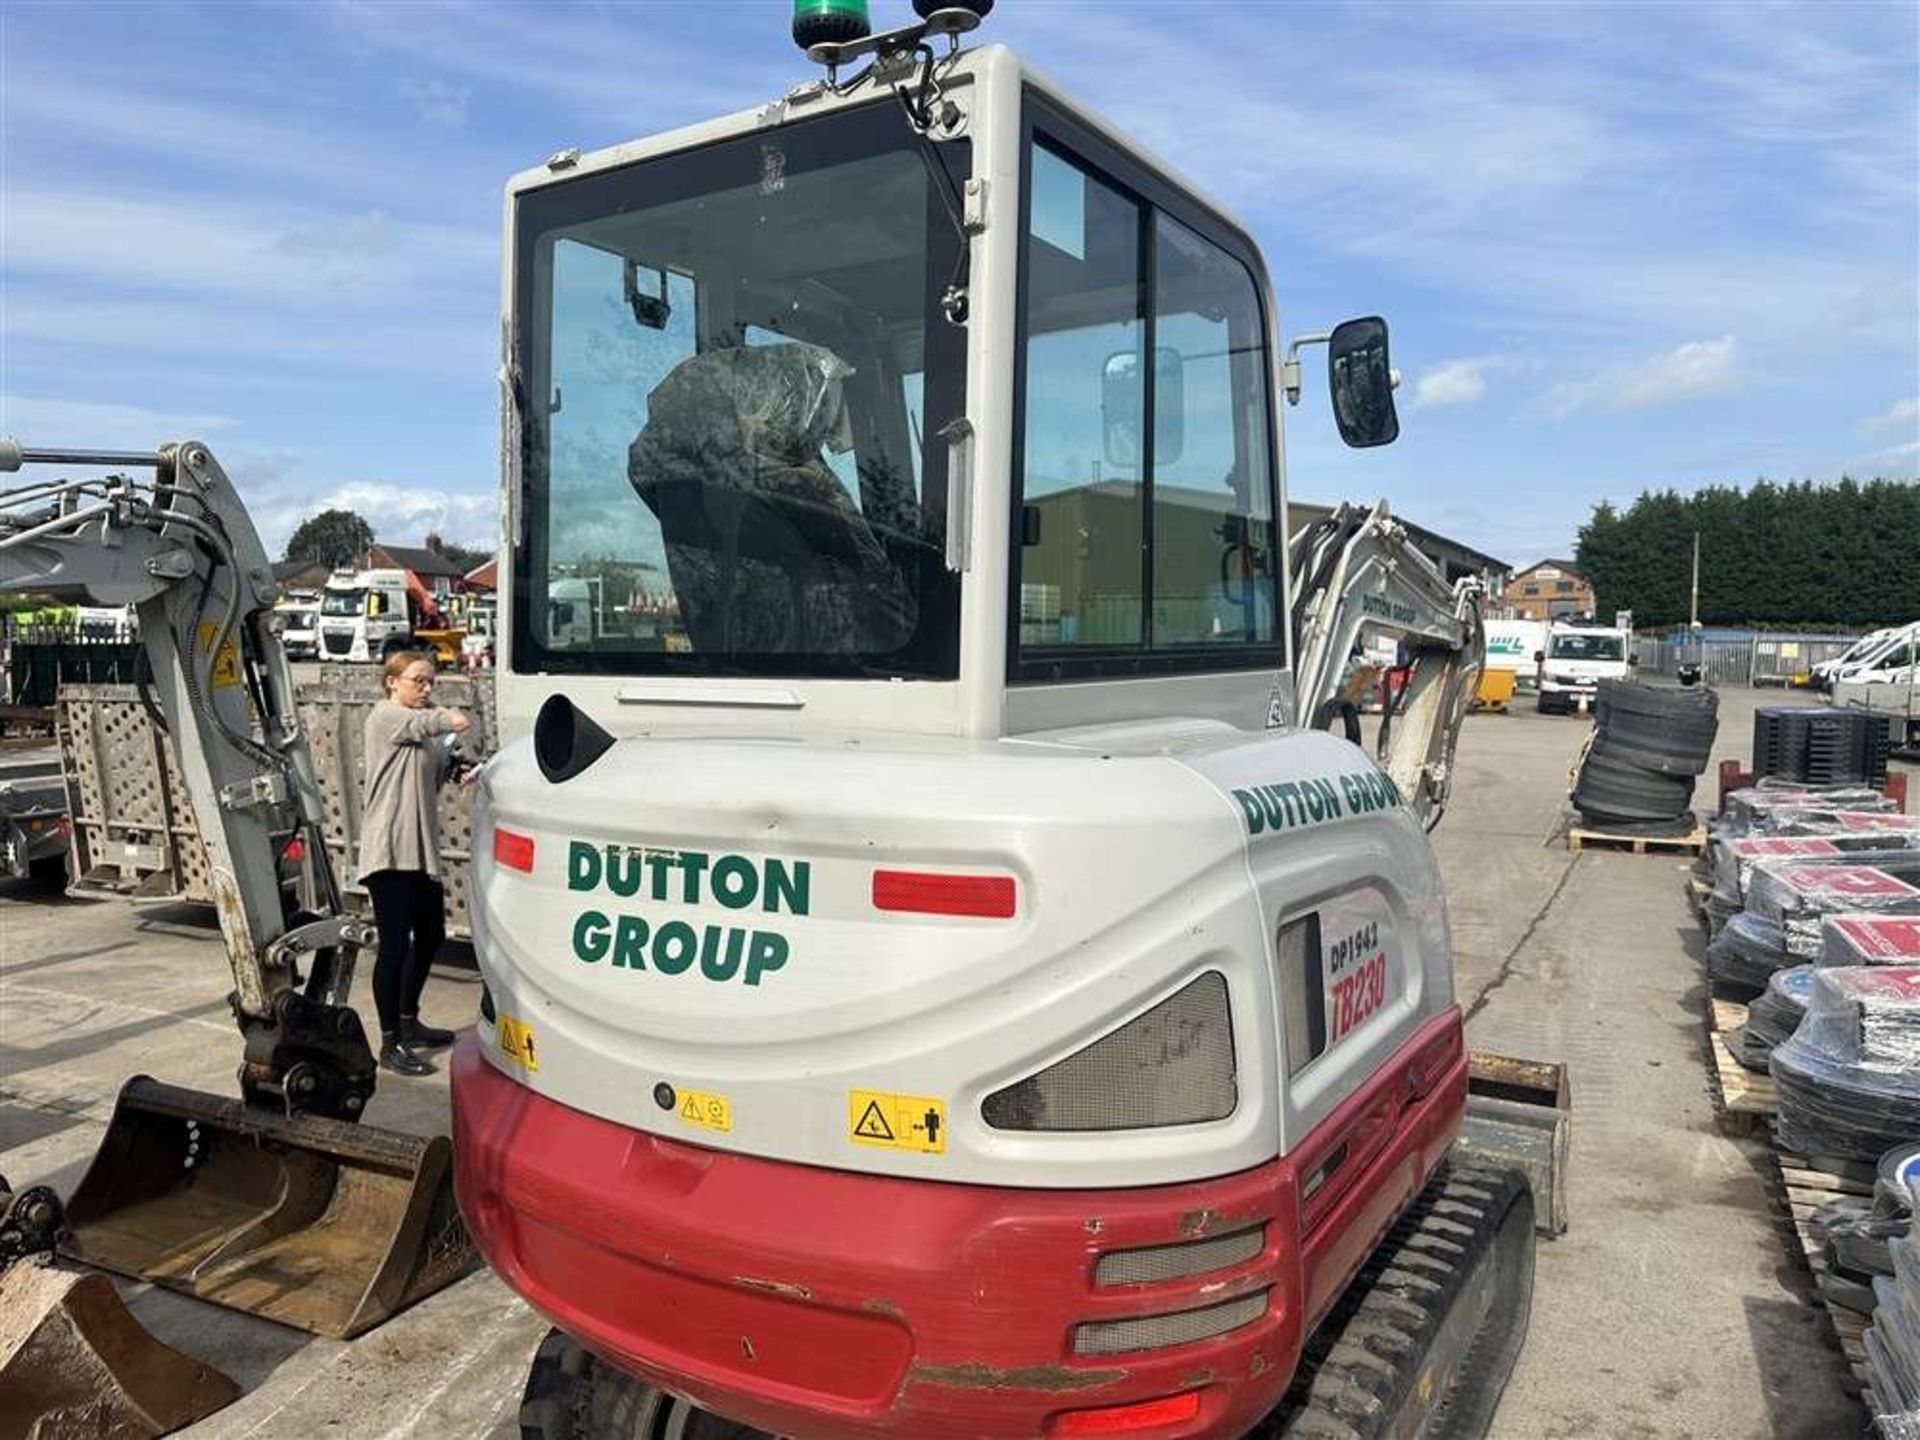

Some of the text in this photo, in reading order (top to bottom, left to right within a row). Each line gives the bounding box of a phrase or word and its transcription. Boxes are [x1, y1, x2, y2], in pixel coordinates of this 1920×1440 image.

[1231, 777, 1342, 834] DUTTON
[568, 841, 811, 916] DUTTON
[572, 910, 790, 986] GROUP
[1331, 951, 1386, 1043] TB230
